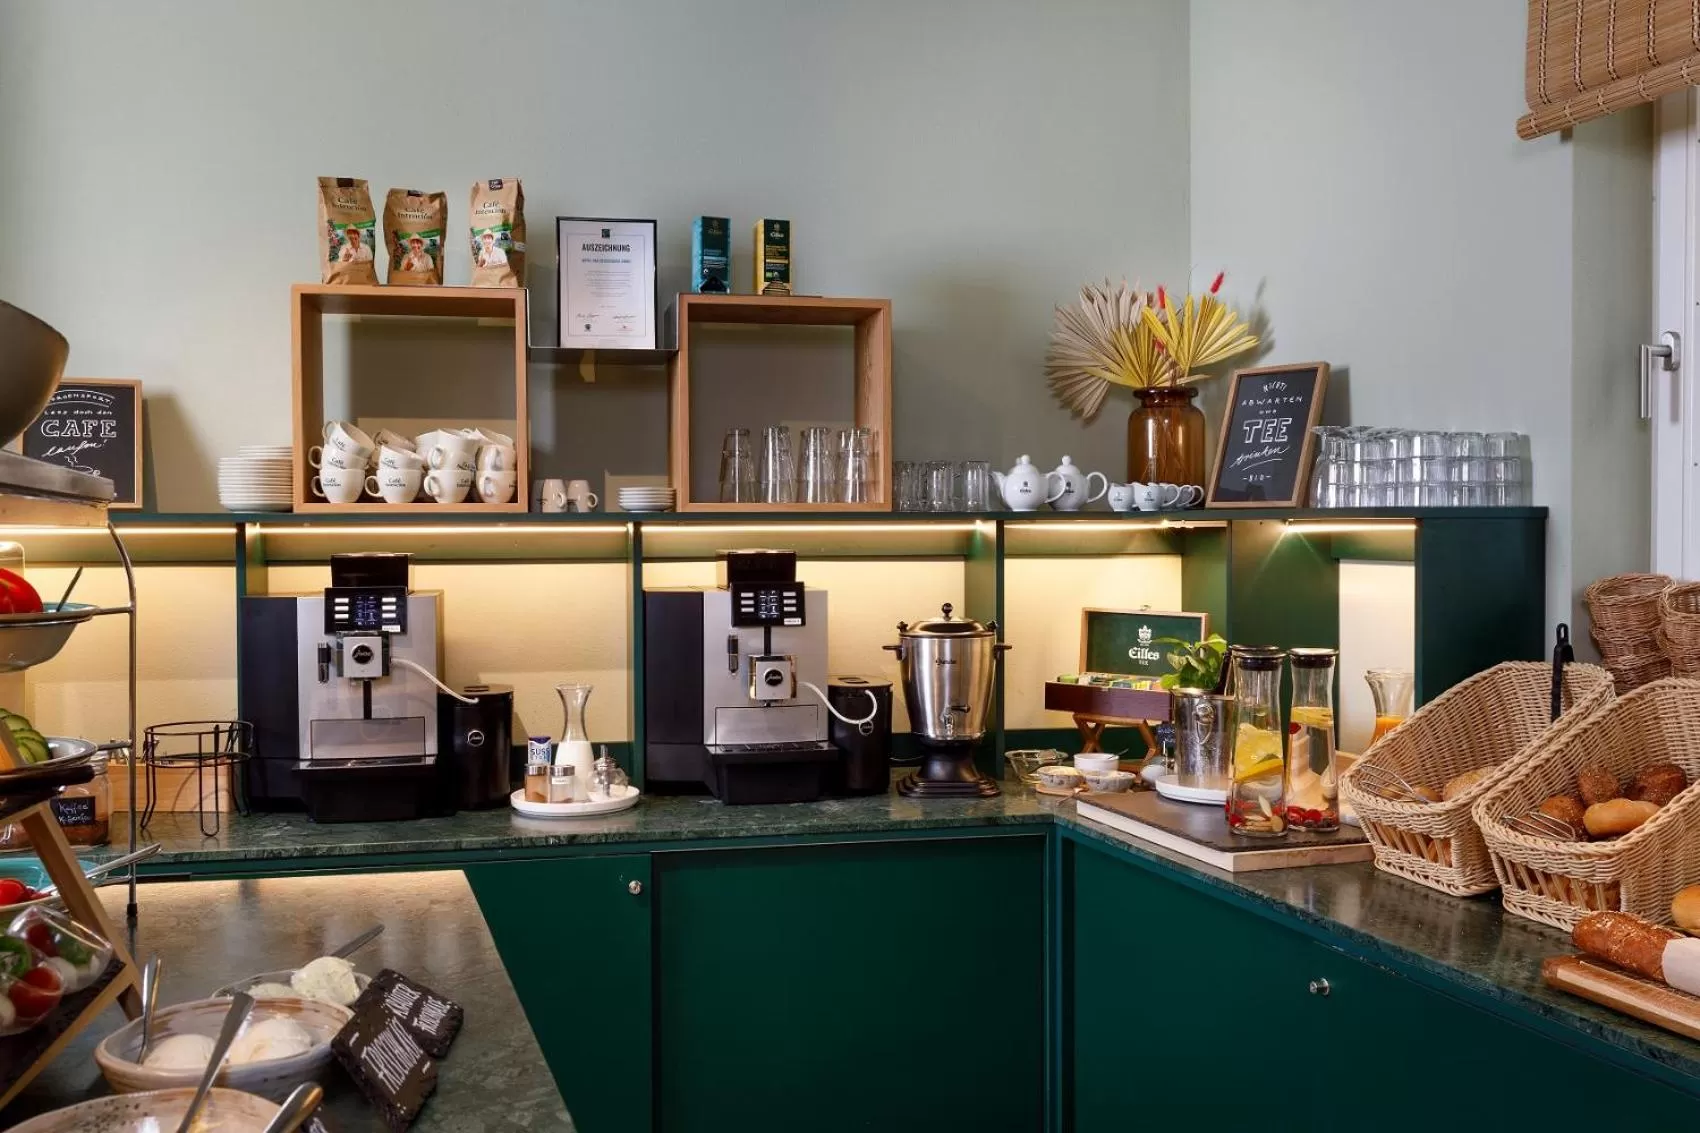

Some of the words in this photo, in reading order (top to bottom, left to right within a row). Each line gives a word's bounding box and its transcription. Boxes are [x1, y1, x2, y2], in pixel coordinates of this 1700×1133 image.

[582, 243, 631, 252] AUSZEICHNUNG
[1241, 396, 1303, 407] ABWARTEN
[40, 419, 118, 438] CAFE
[1243, 417, 1293, 443] TEE
[1128, 646, 1160, 661] Eilles
[360, 1015, 424, 1094] FRISCHKÄSE
